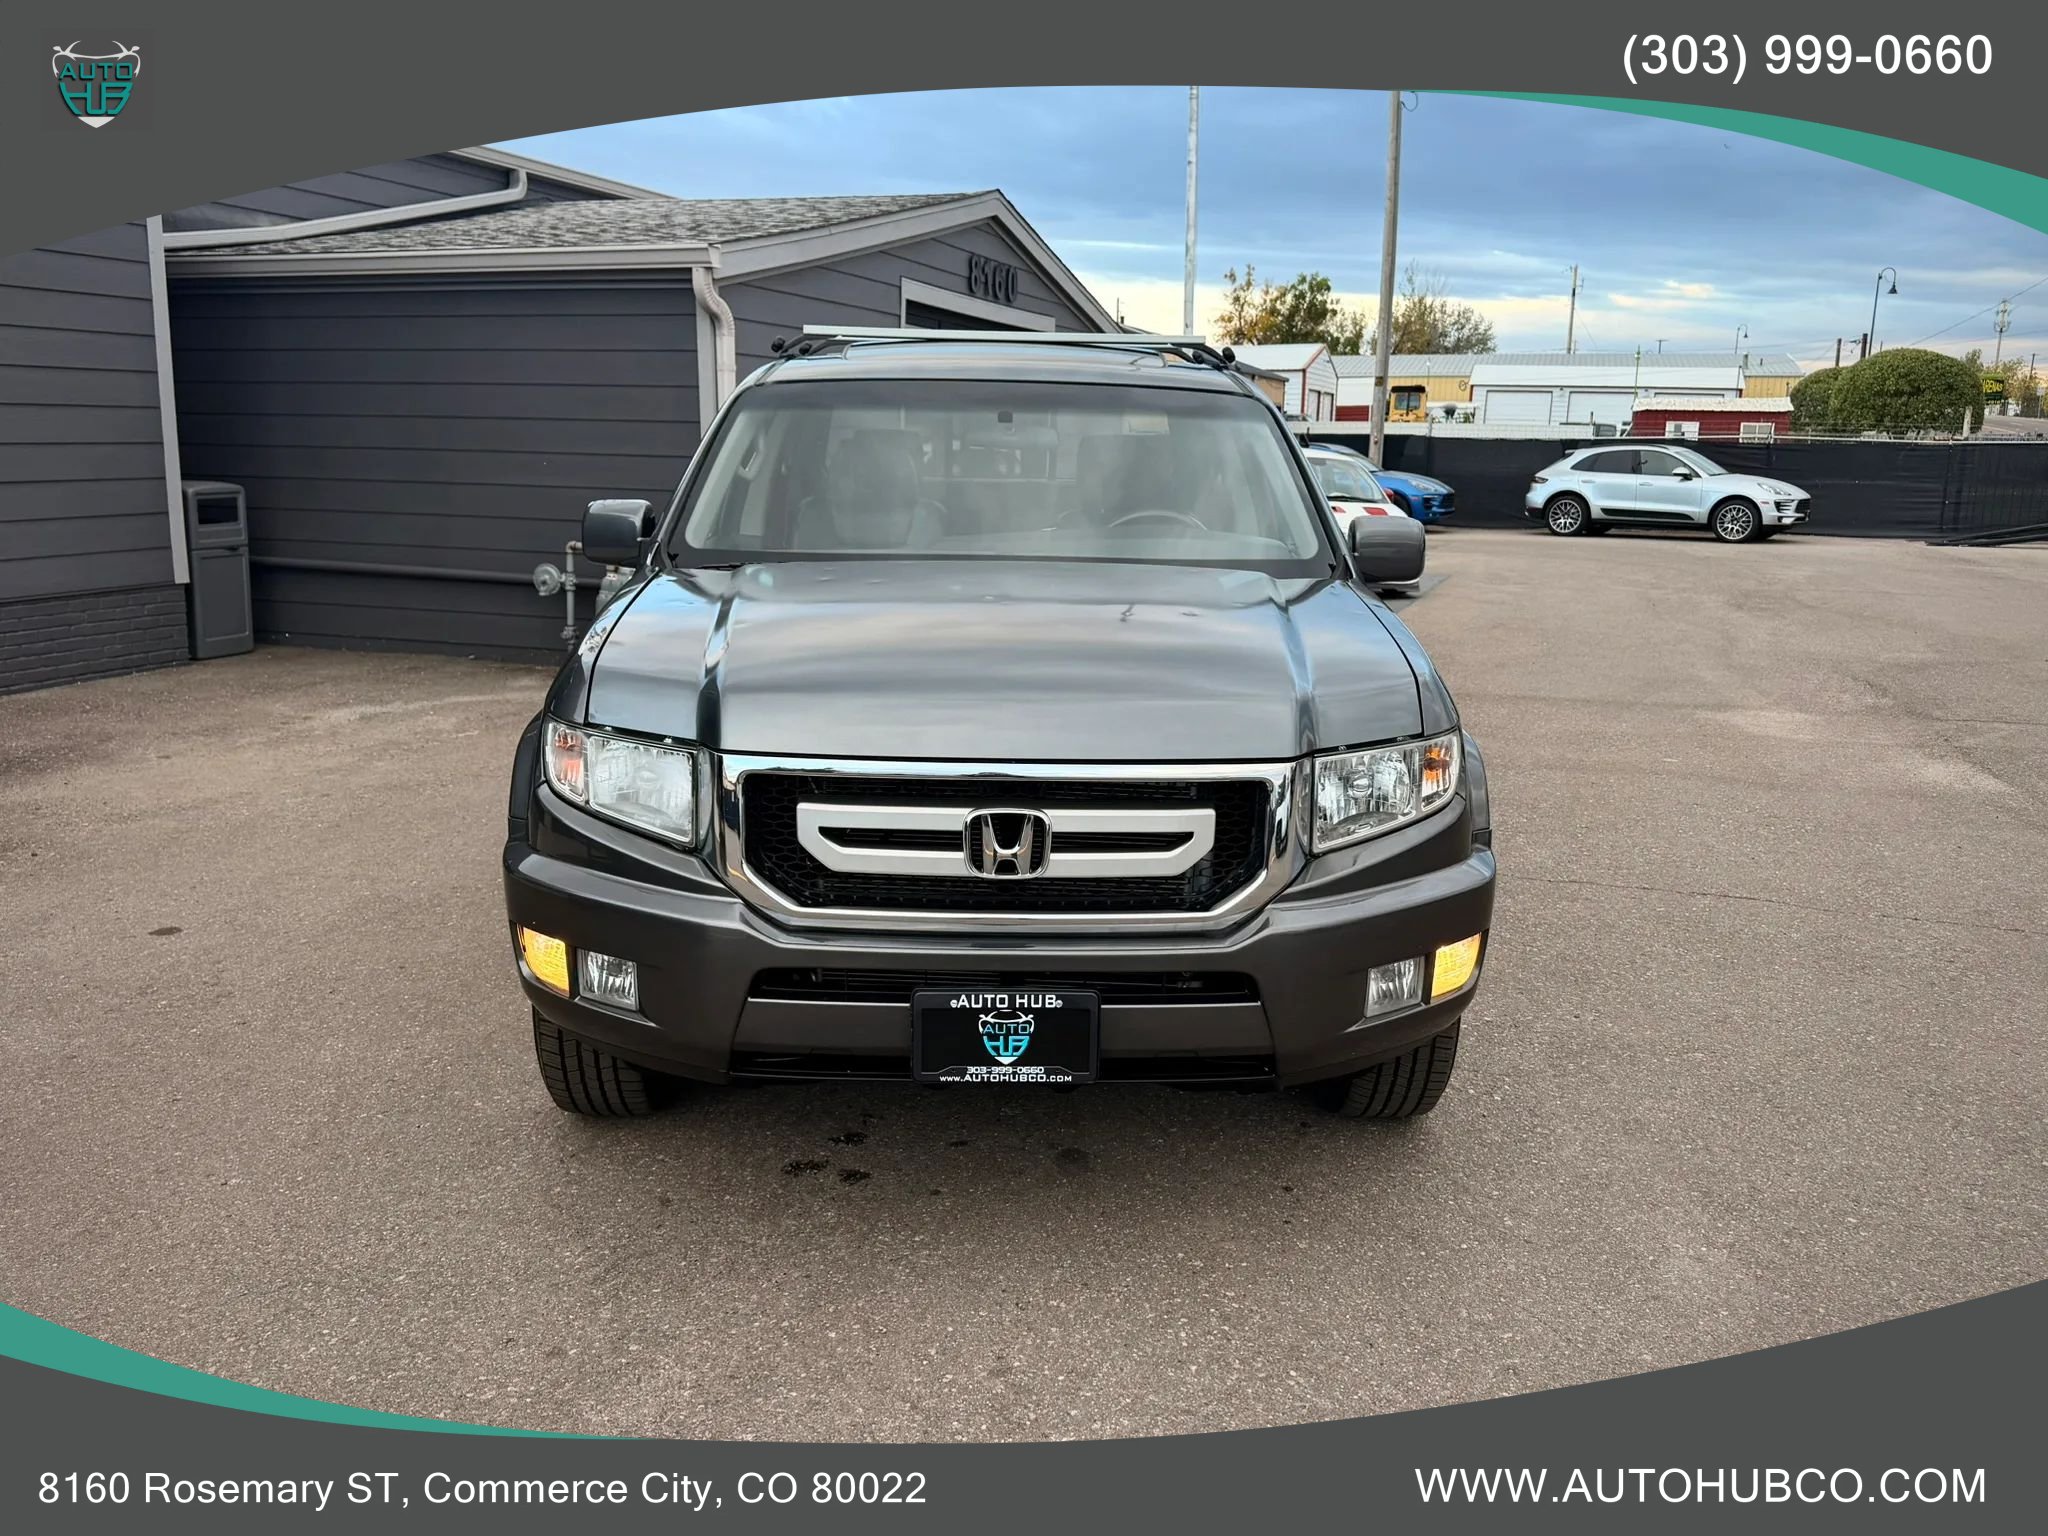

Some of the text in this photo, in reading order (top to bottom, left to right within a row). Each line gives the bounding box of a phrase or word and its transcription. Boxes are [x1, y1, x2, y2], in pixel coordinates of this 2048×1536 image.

[969, 254, 1018, 304] 8160
[957, 994, 1057, 1008] AUTO HUB
[983, 1023, 1030, 1034] AUTO
[966, 1066, 1045, 1074] 303-999-0660
